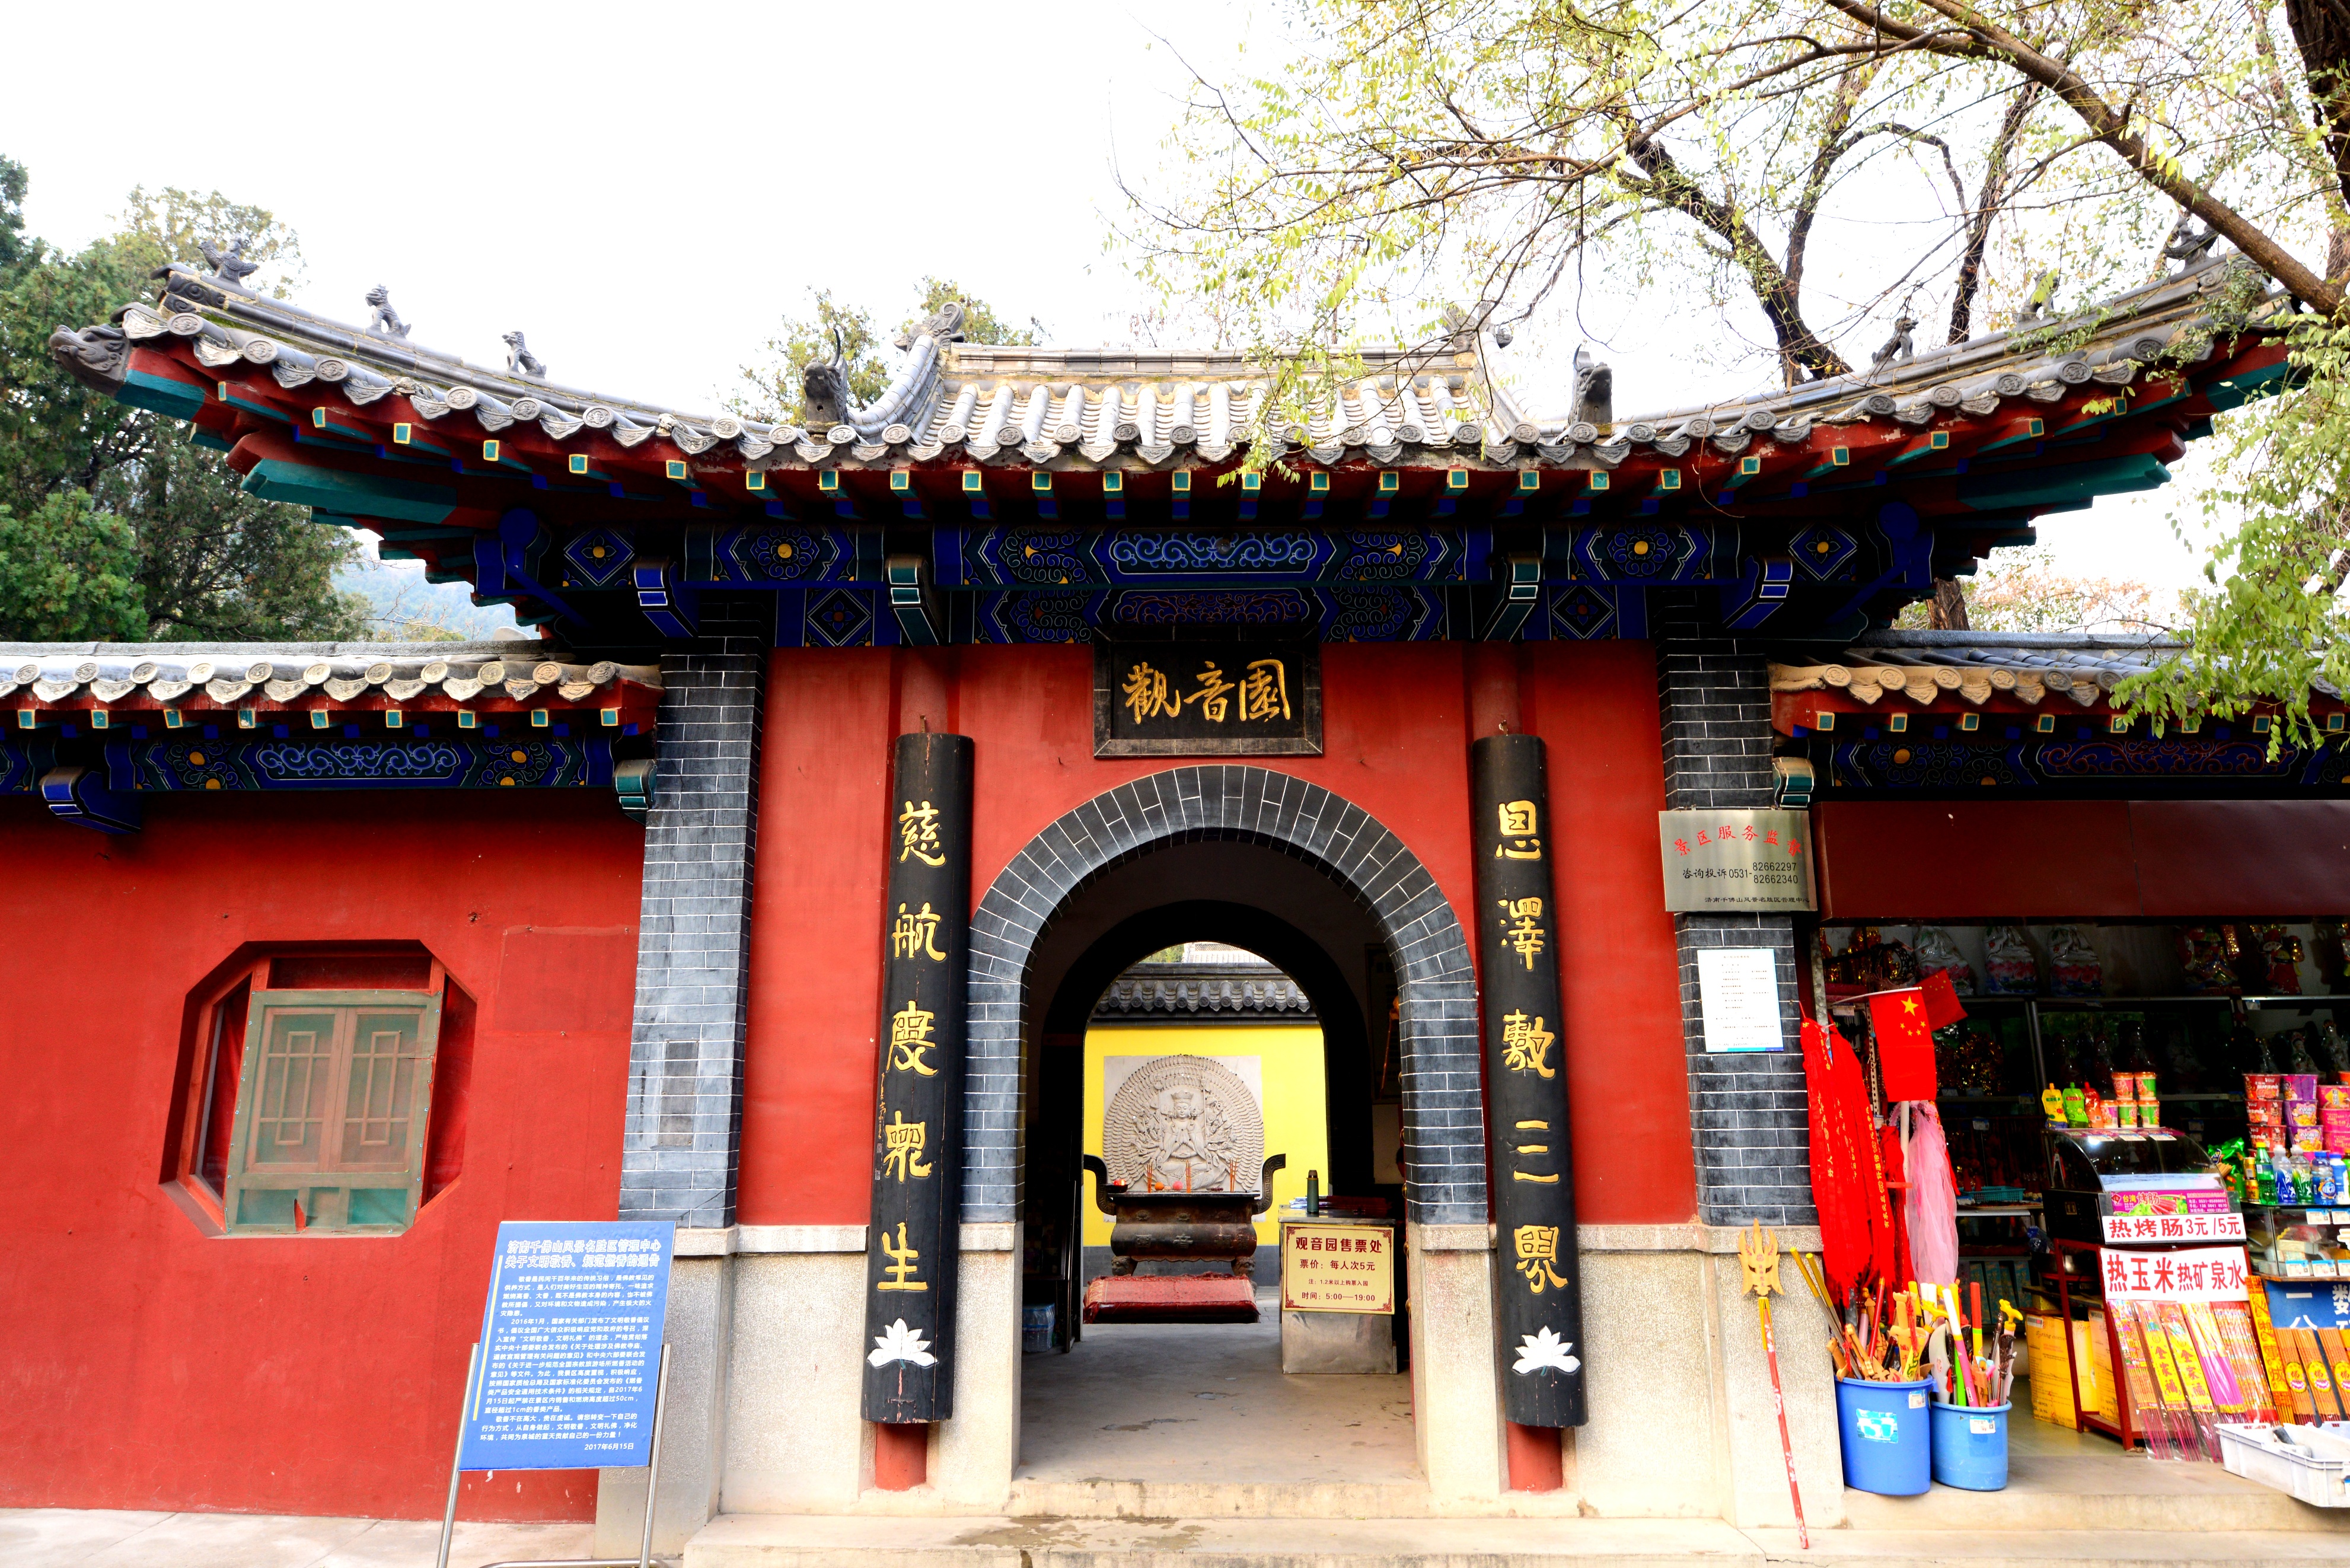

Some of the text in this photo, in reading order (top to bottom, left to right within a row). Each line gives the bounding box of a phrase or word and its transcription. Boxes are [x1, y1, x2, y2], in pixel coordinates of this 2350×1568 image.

[1673, 825, 1803, 857] 景区服务监督
[1752, 862, 1797, 871] 82662297
[1753, 874, 1799, 884] 82662340
[2137, 1191, 2160, 1204] 烤肠
[506, 1239, 661, 1254] 济南千佛山风景名胜区管理中心
[1295, 1236, 1382, 1253] 观音园售票处
